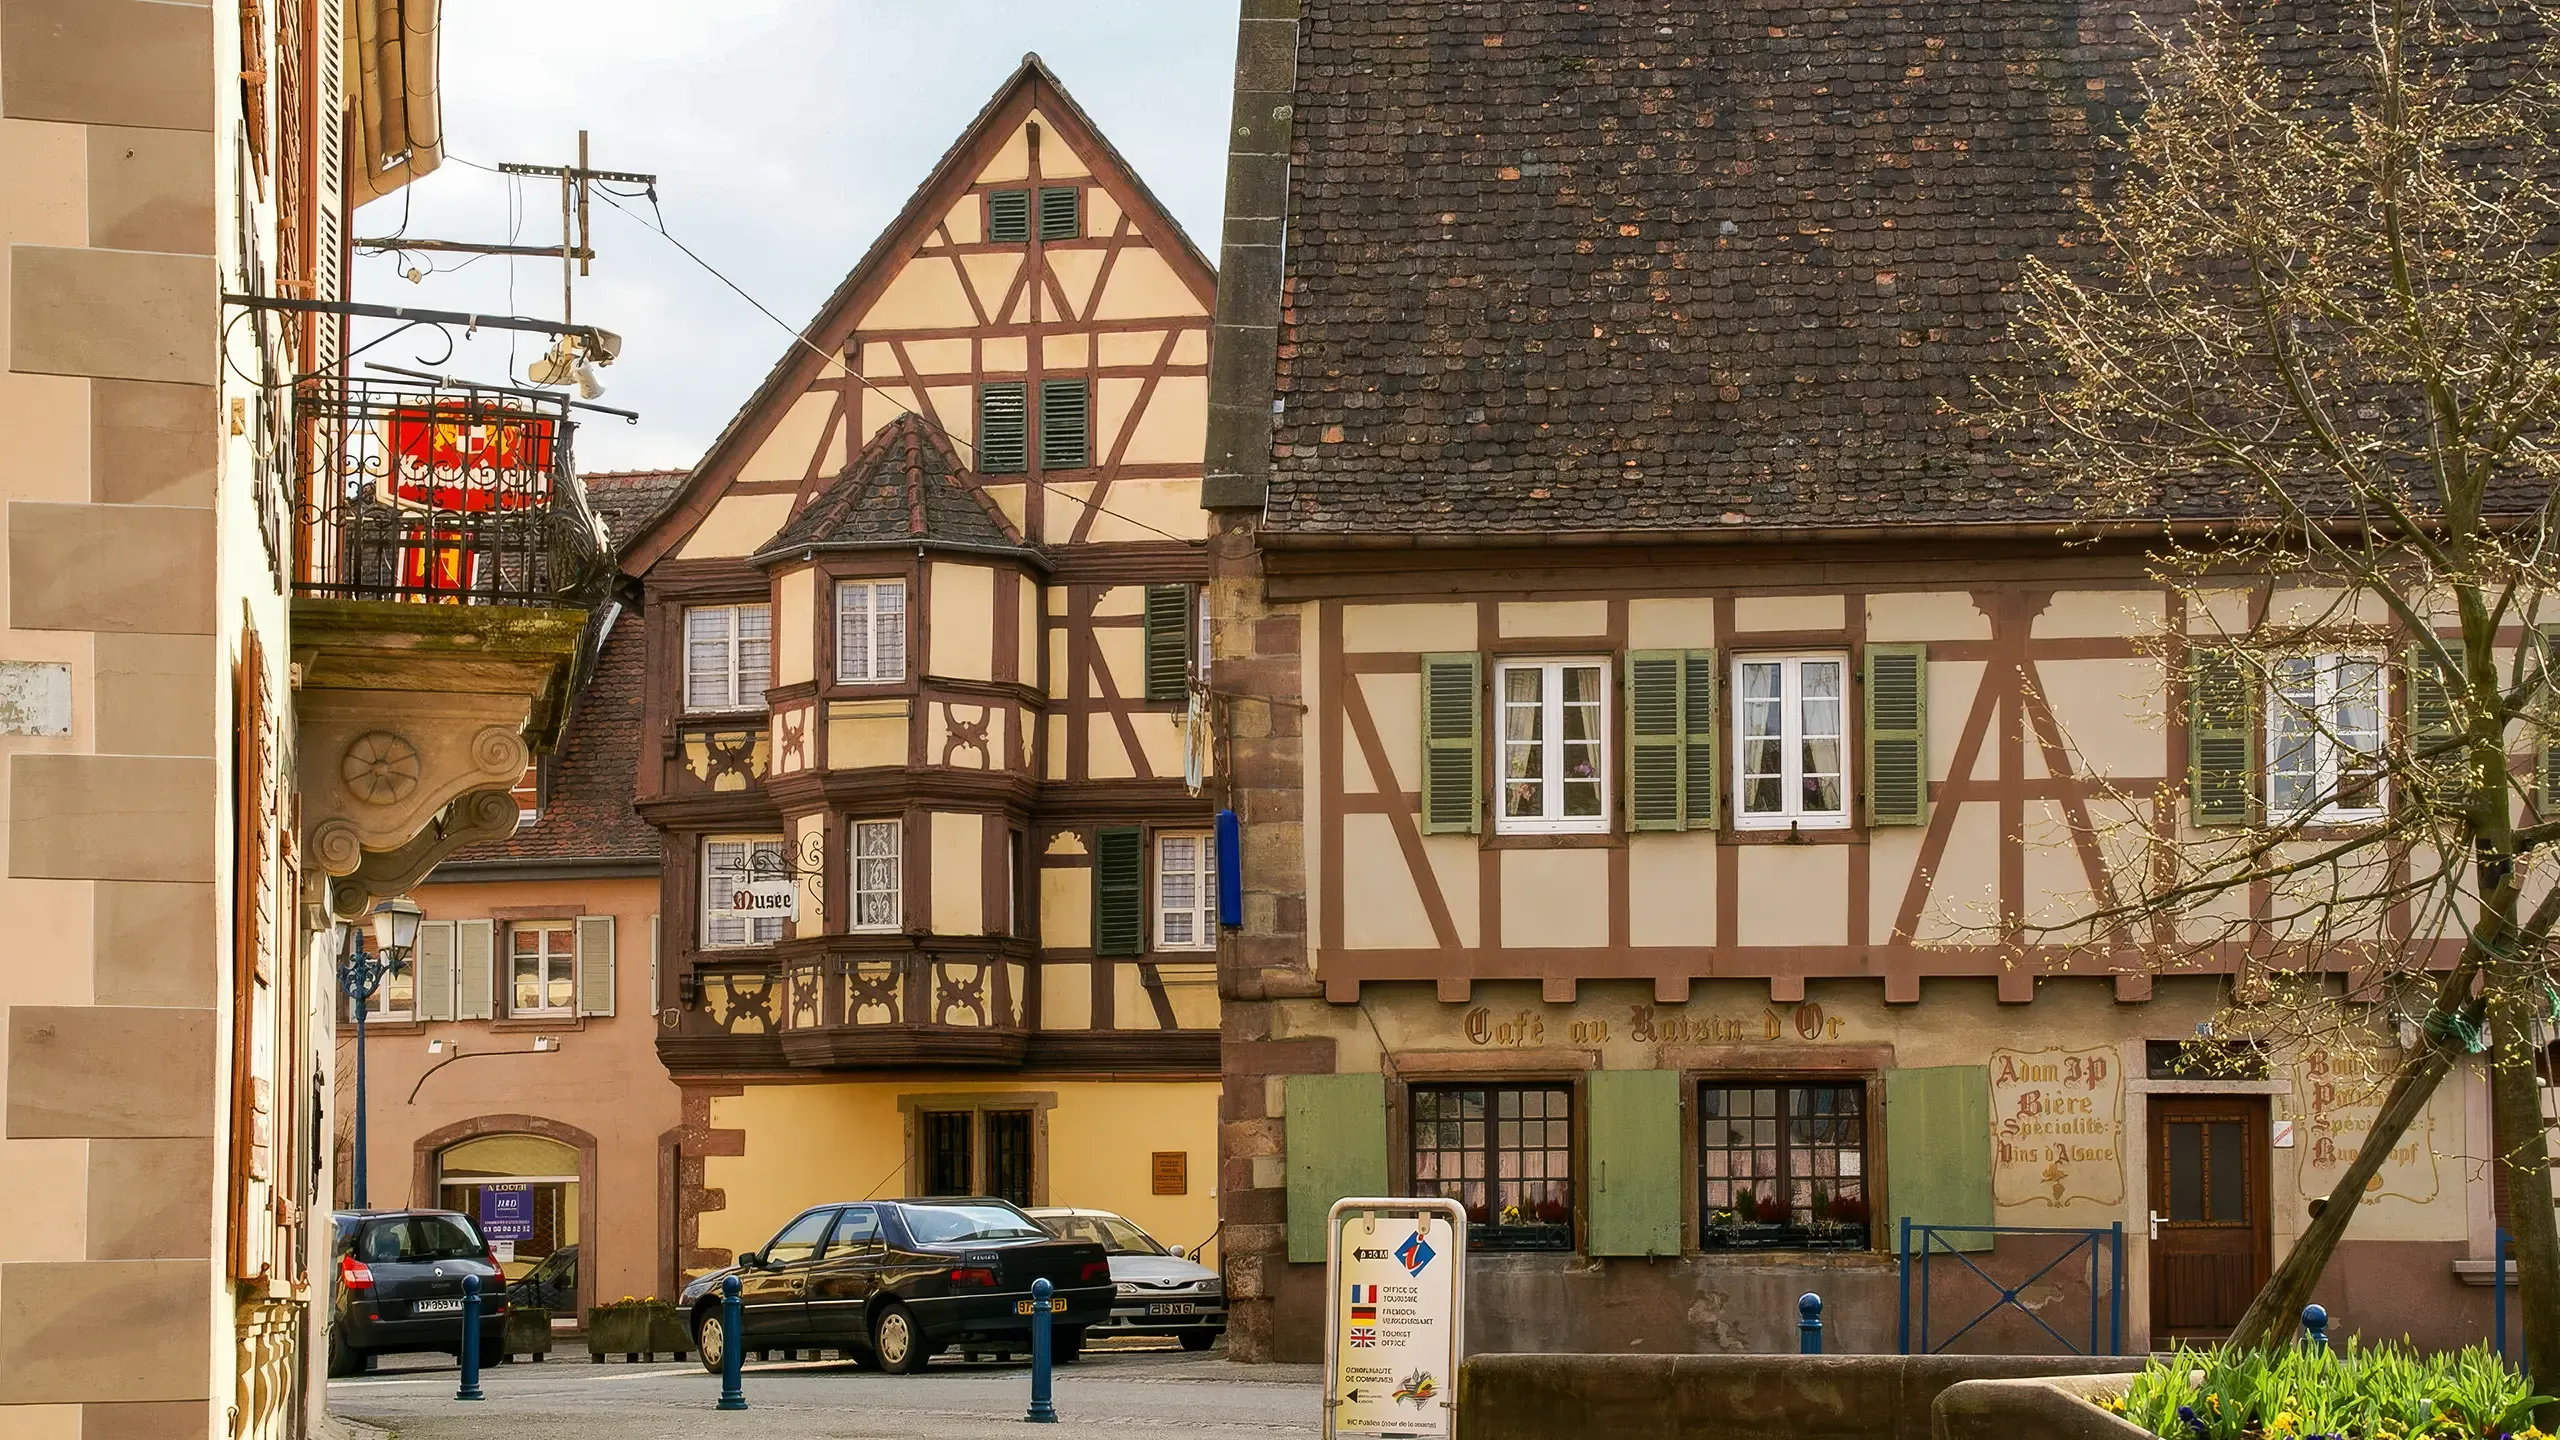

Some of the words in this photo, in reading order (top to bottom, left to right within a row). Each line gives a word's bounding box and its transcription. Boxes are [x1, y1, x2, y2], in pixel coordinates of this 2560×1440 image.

[733, 890, 792, 910] Musée
[1464, 1006, 1545, 1047] Café
[1570, 1020, 1611, 1043] au
[1631, 1004, 1744, 1043] Raisin
[1996, 1055, 2060, 1090] Adam
[2017, 1089, 2093, 1120] Bière
[1999, 1140, 2038, 1164] Vins
